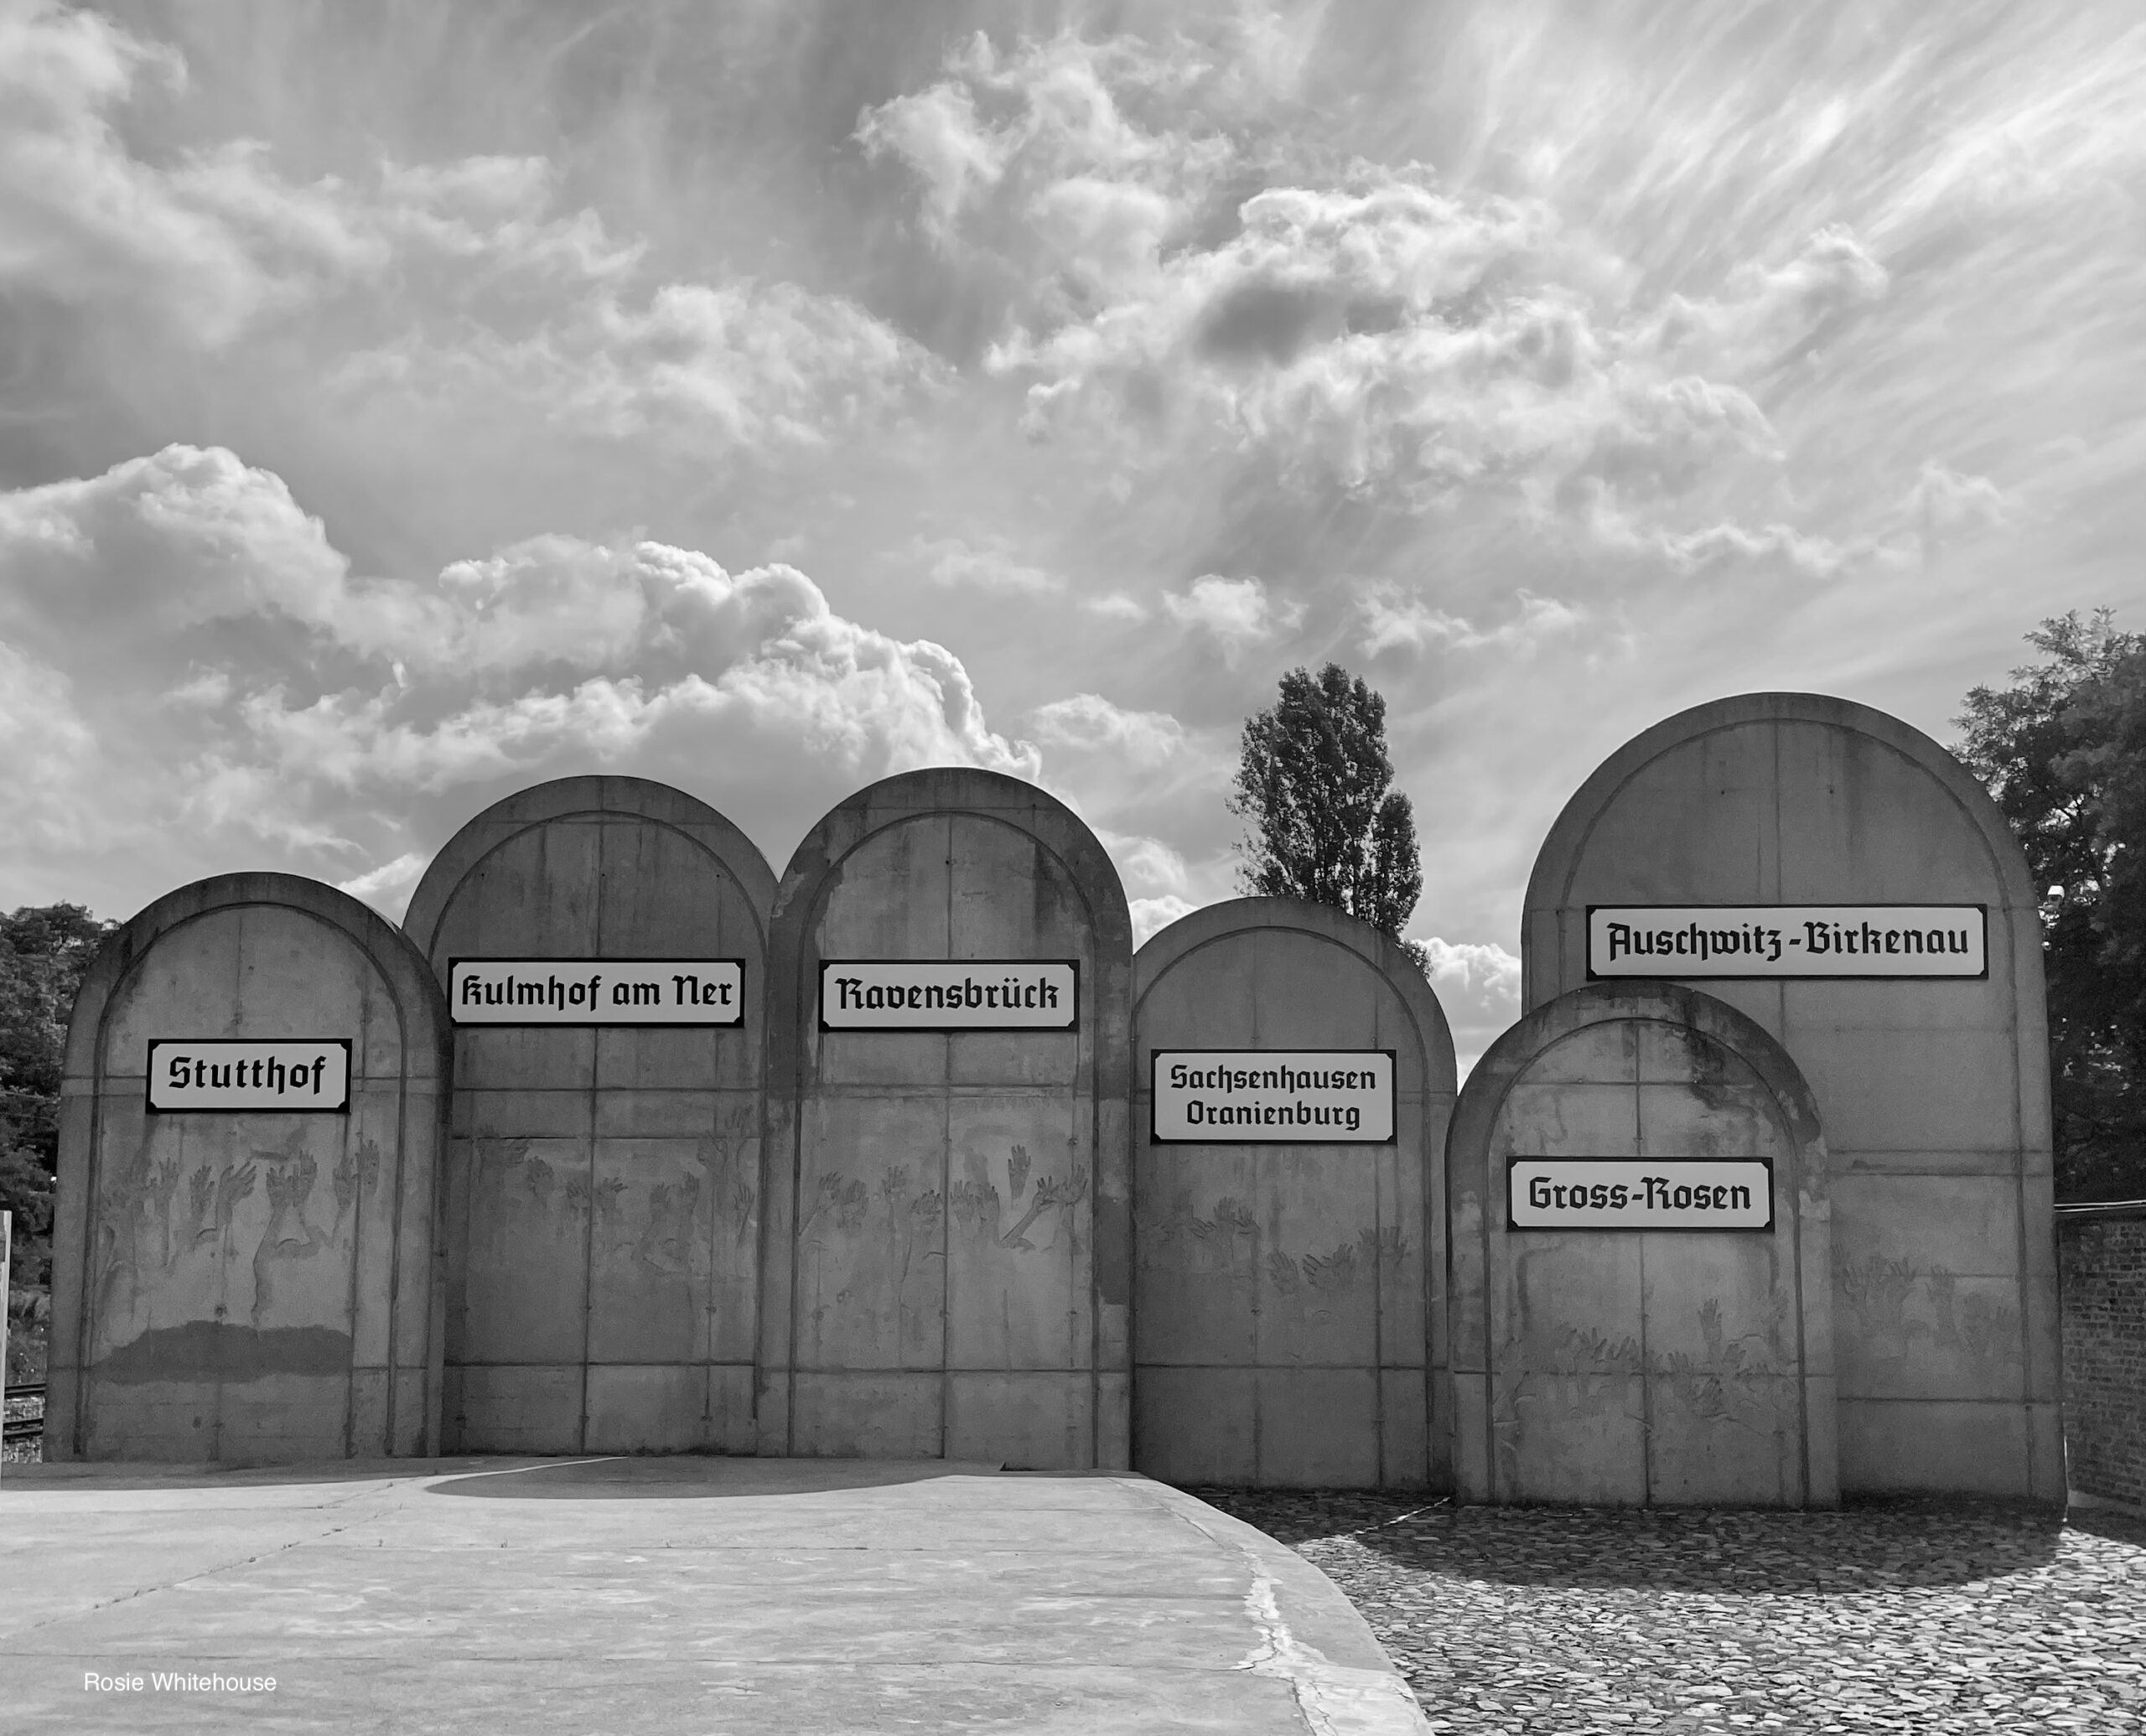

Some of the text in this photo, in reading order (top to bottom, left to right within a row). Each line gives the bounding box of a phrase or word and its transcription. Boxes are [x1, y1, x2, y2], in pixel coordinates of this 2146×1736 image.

[461, 974, 733, 1013] Kulmhof am Ner
[834, 977, 1060, 1010] Ravensbrück
[168, 1055, 327, 1096] Stutthof
[1170, 1064, 1376, 1094] Sachsenhausen
[1186, 1099, 1361, 1132] Oranienburg
[1529, 1176, 1751, 1210] Gross-Rosen
